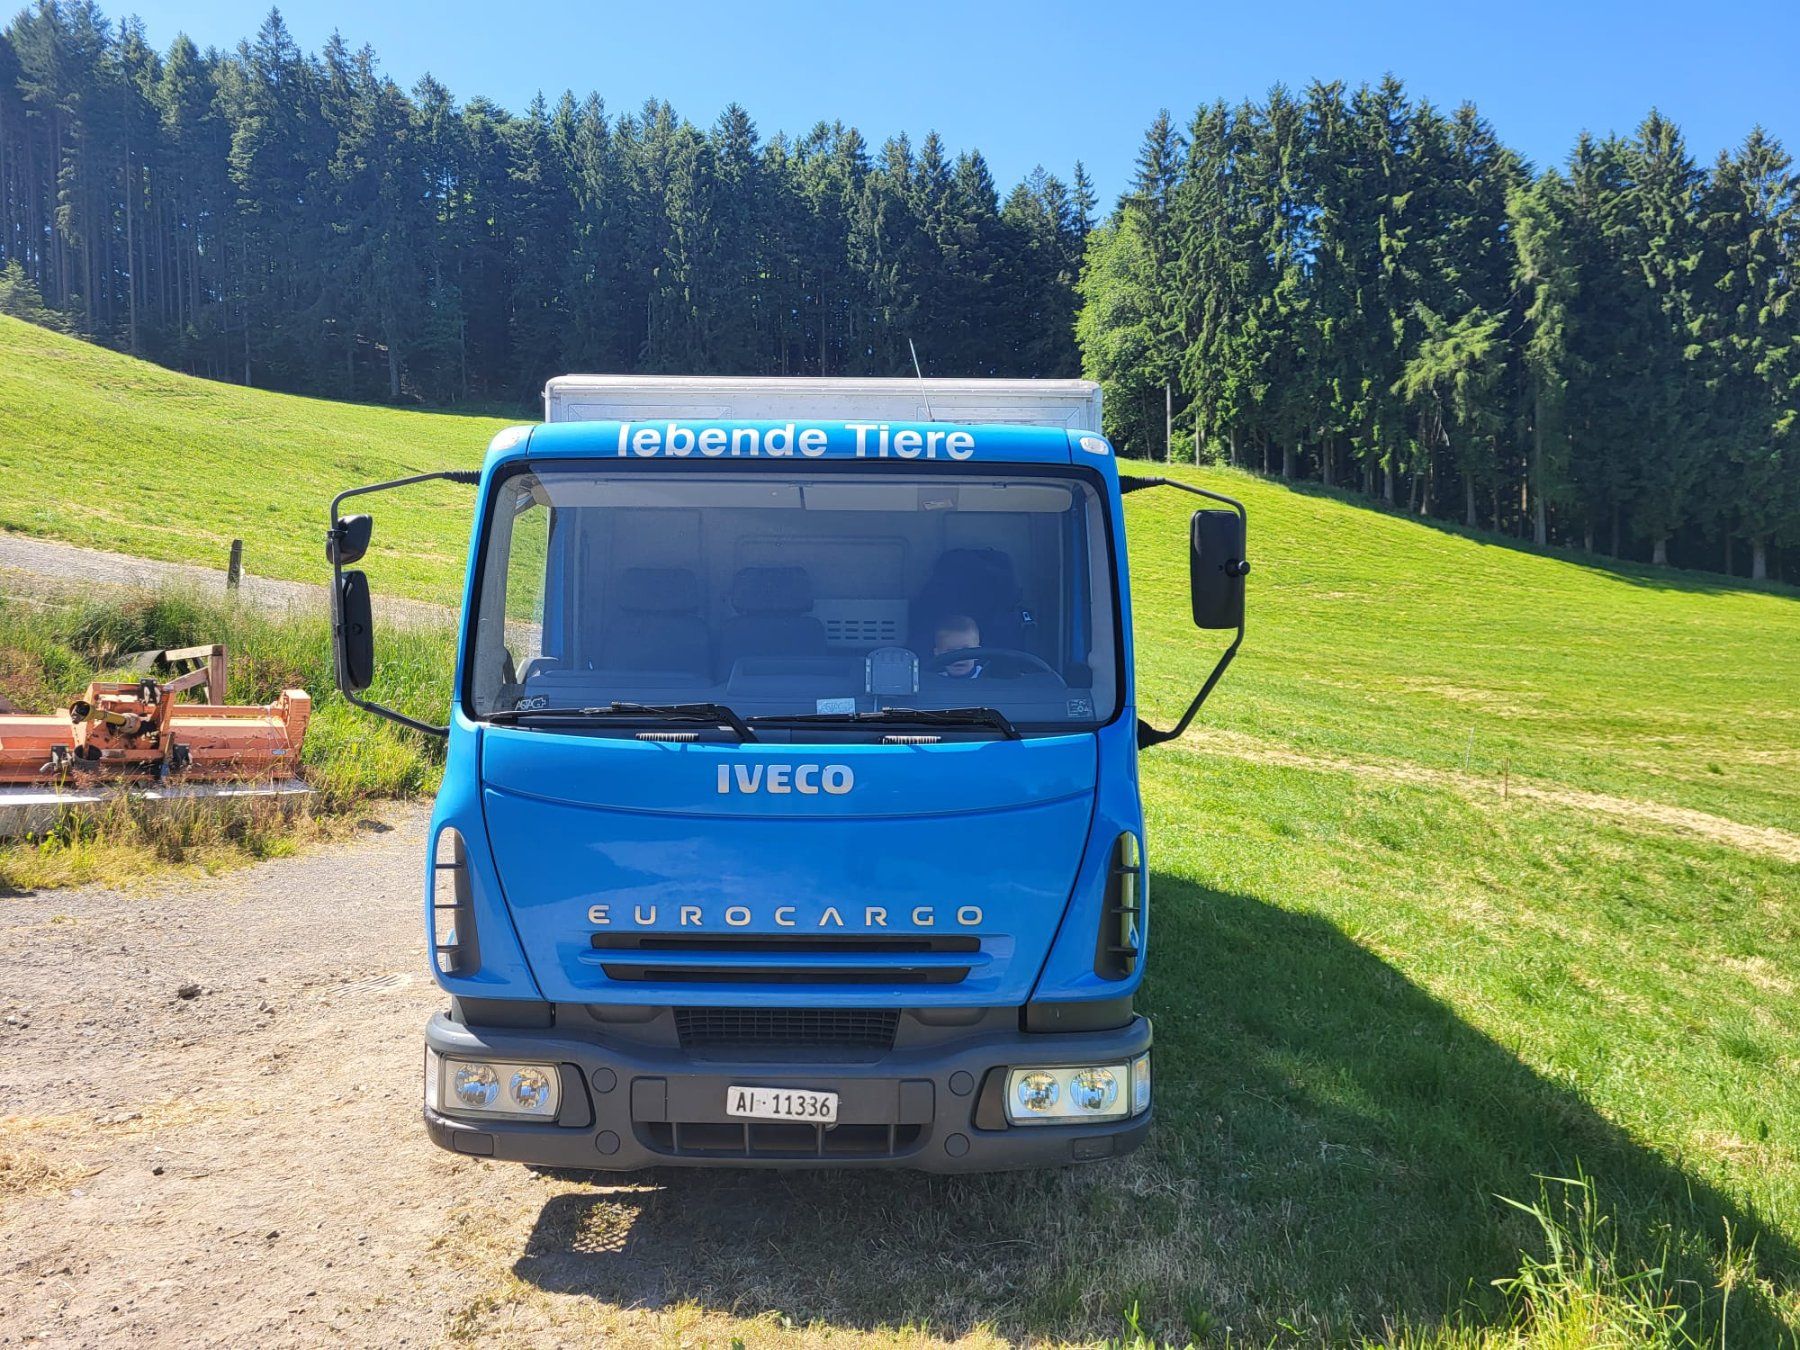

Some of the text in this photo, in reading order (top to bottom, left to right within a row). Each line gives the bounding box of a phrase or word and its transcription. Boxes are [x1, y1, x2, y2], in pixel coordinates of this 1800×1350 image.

[618, 423, 975, 460] lebende Tiere
[717, 764, 855, 795] IVECO
[587, 904, 983, 927] EUROCARGO
